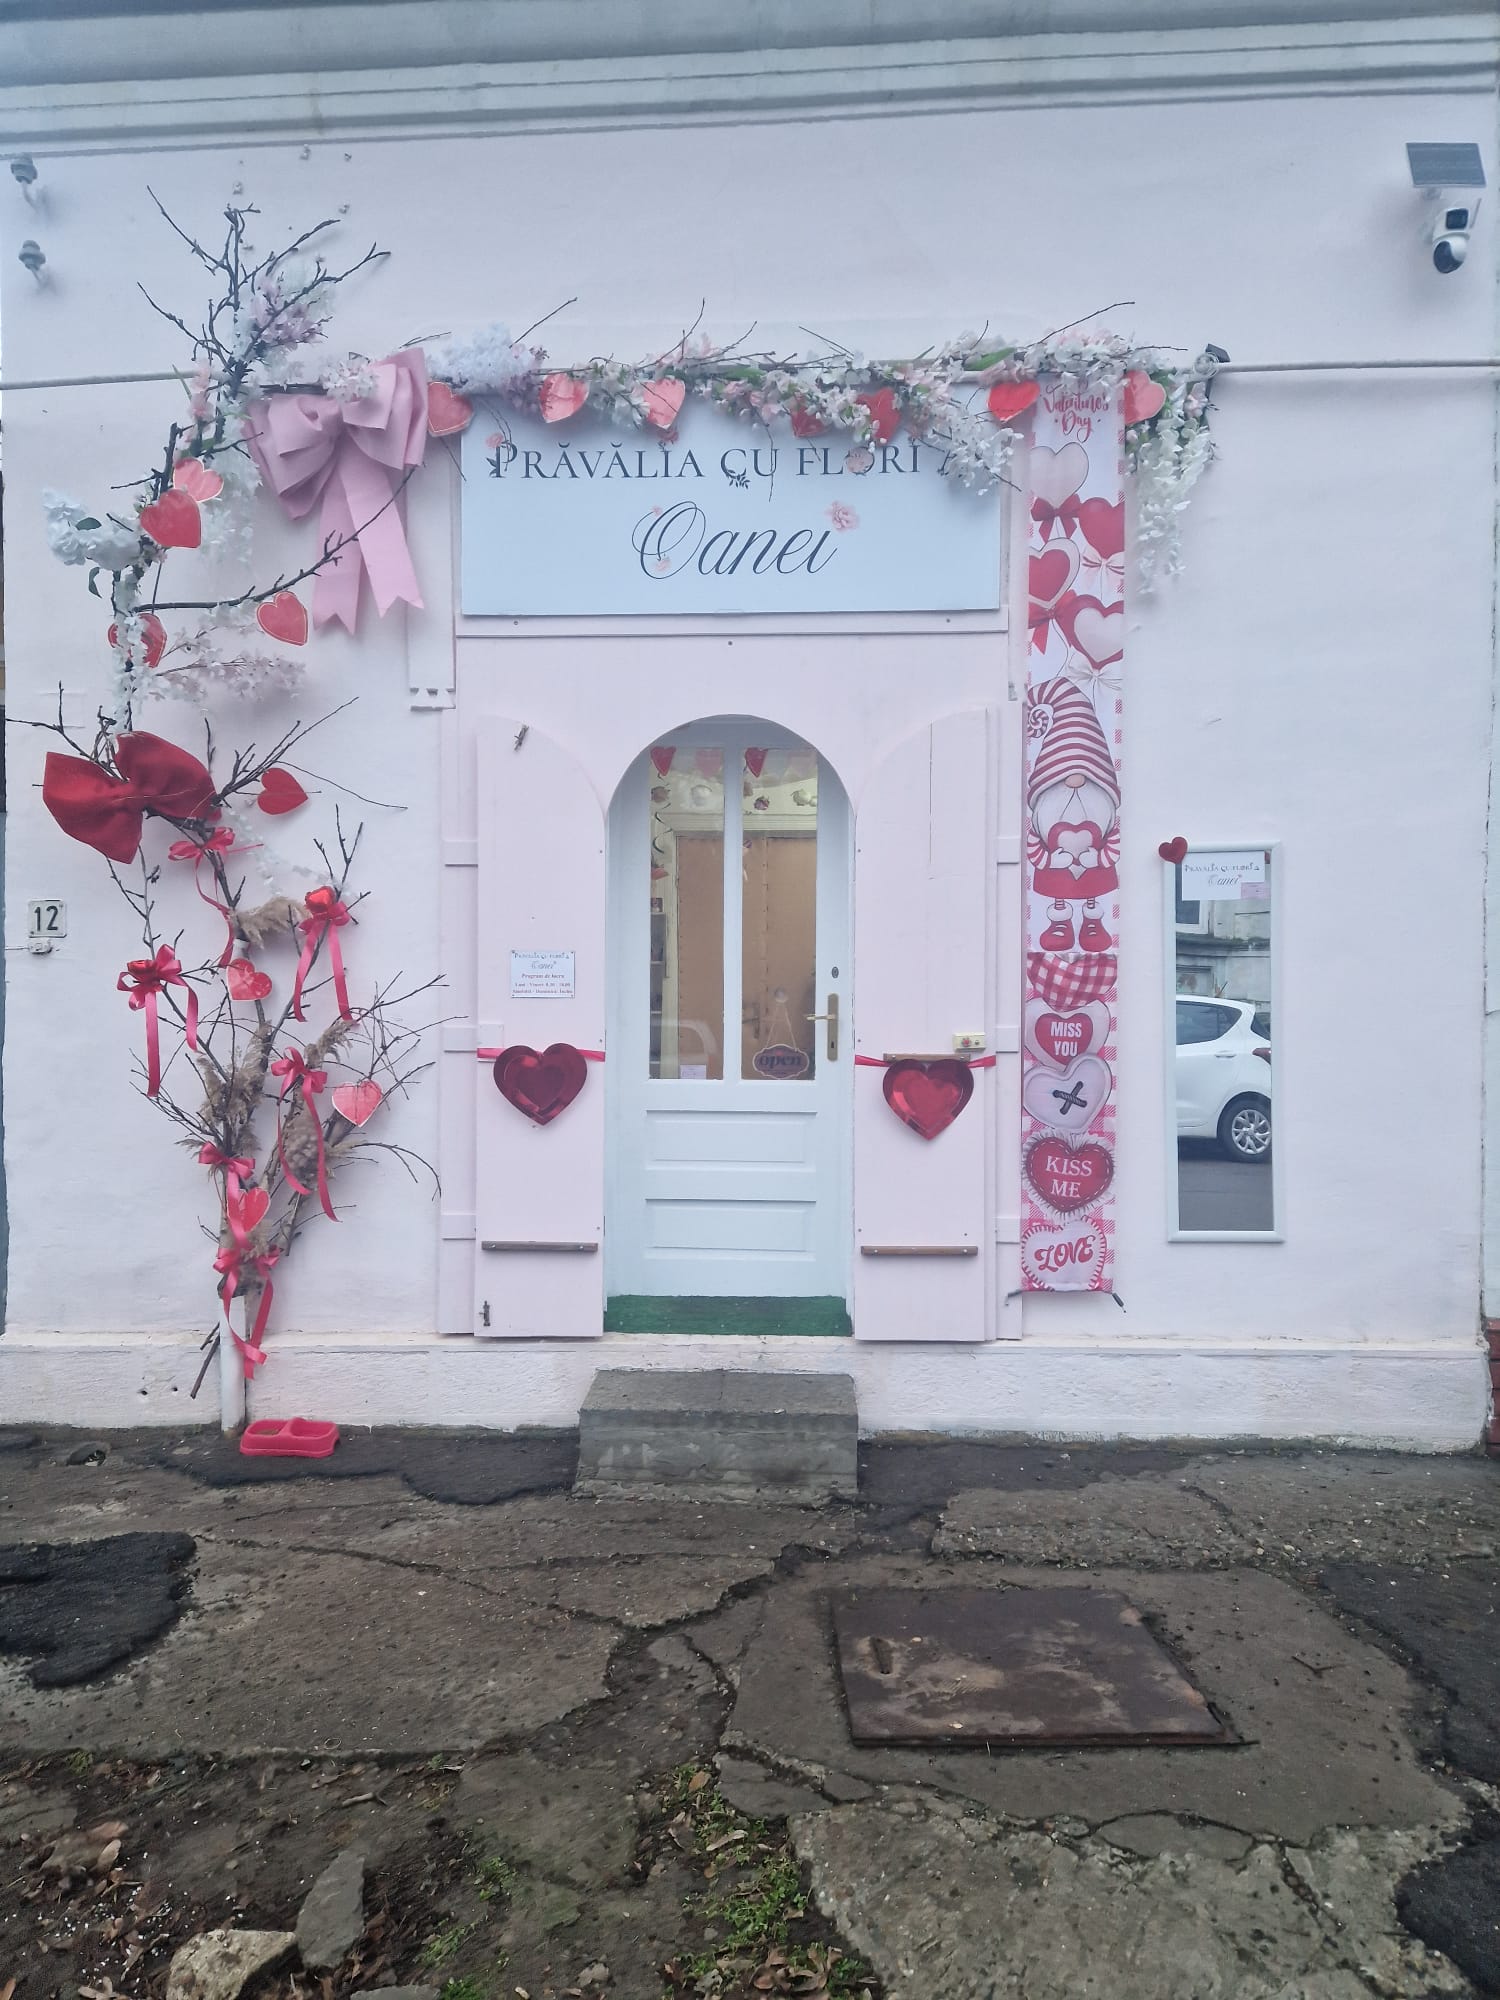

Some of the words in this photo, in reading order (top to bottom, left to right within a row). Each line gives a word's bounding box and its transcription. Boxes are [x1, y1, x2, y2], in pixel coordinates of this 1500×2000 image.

[1062, 410, 1091, 443] Day
[488, 440, 705, 479] PRĂVĂLIA
[720, 448, 780, 478] CU
[796, 445, 921, 476] FLORI
[631, 500, 838, 579] Oanei
[34, 905, 59, 932] 12
[1050, 1021, 1082, 1038] MISS
[1053, 1040, 1079, 1057] YOU
[758, 1054, 800, 1069] open
[1045, 1155, 1093, 1177] KISS
[1050, 1178, 1082, 1198] ME
[1034, 1235, 1096, 1273] LOVE
